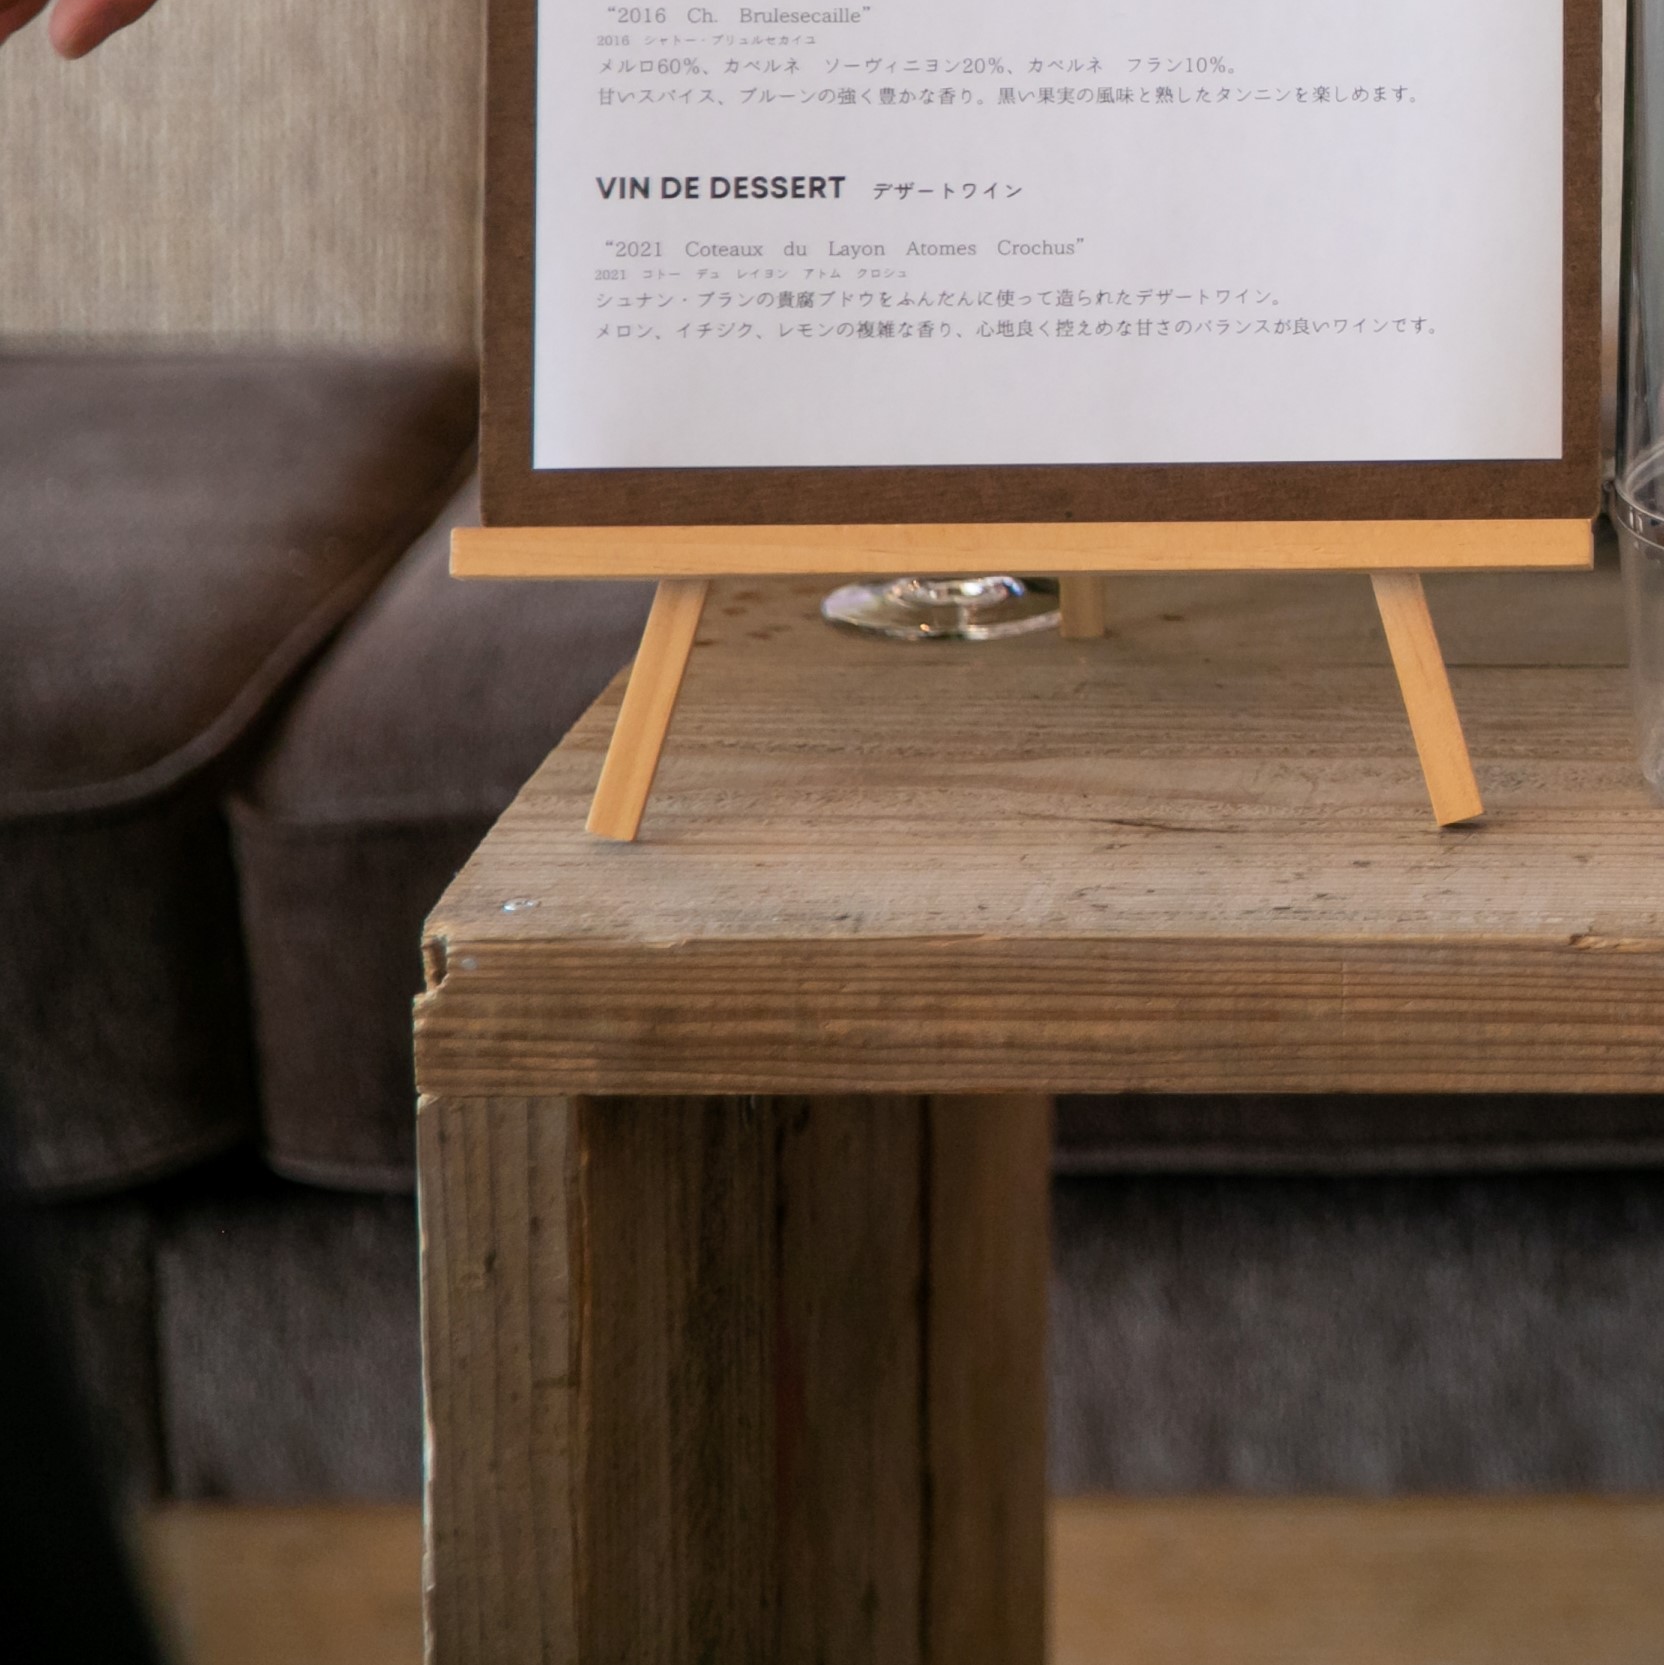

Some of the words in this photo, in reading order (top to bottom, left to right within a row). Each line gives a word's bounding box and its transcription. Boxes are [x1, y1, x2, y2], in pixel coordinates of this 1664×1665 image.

[686, 6, 719, 24] Ch.
[596, 34, 631, 47] 2016
[1127, 55, 1235, 75] フラン10%。
[594, 175, 651, 201] VIN
[660, 175, 700, 201] DE
[709, 175, 848, 201] DESSERT
[871, 180, 1023, 201] デザートワイン
[684, 240, 764, 258] Coteaux
[783, 240, 808, 257] du
[828, 240, 886, 261] Layon
[905, 240, 977, 257] Atomes
[594, 268, 627, 281] 2021
